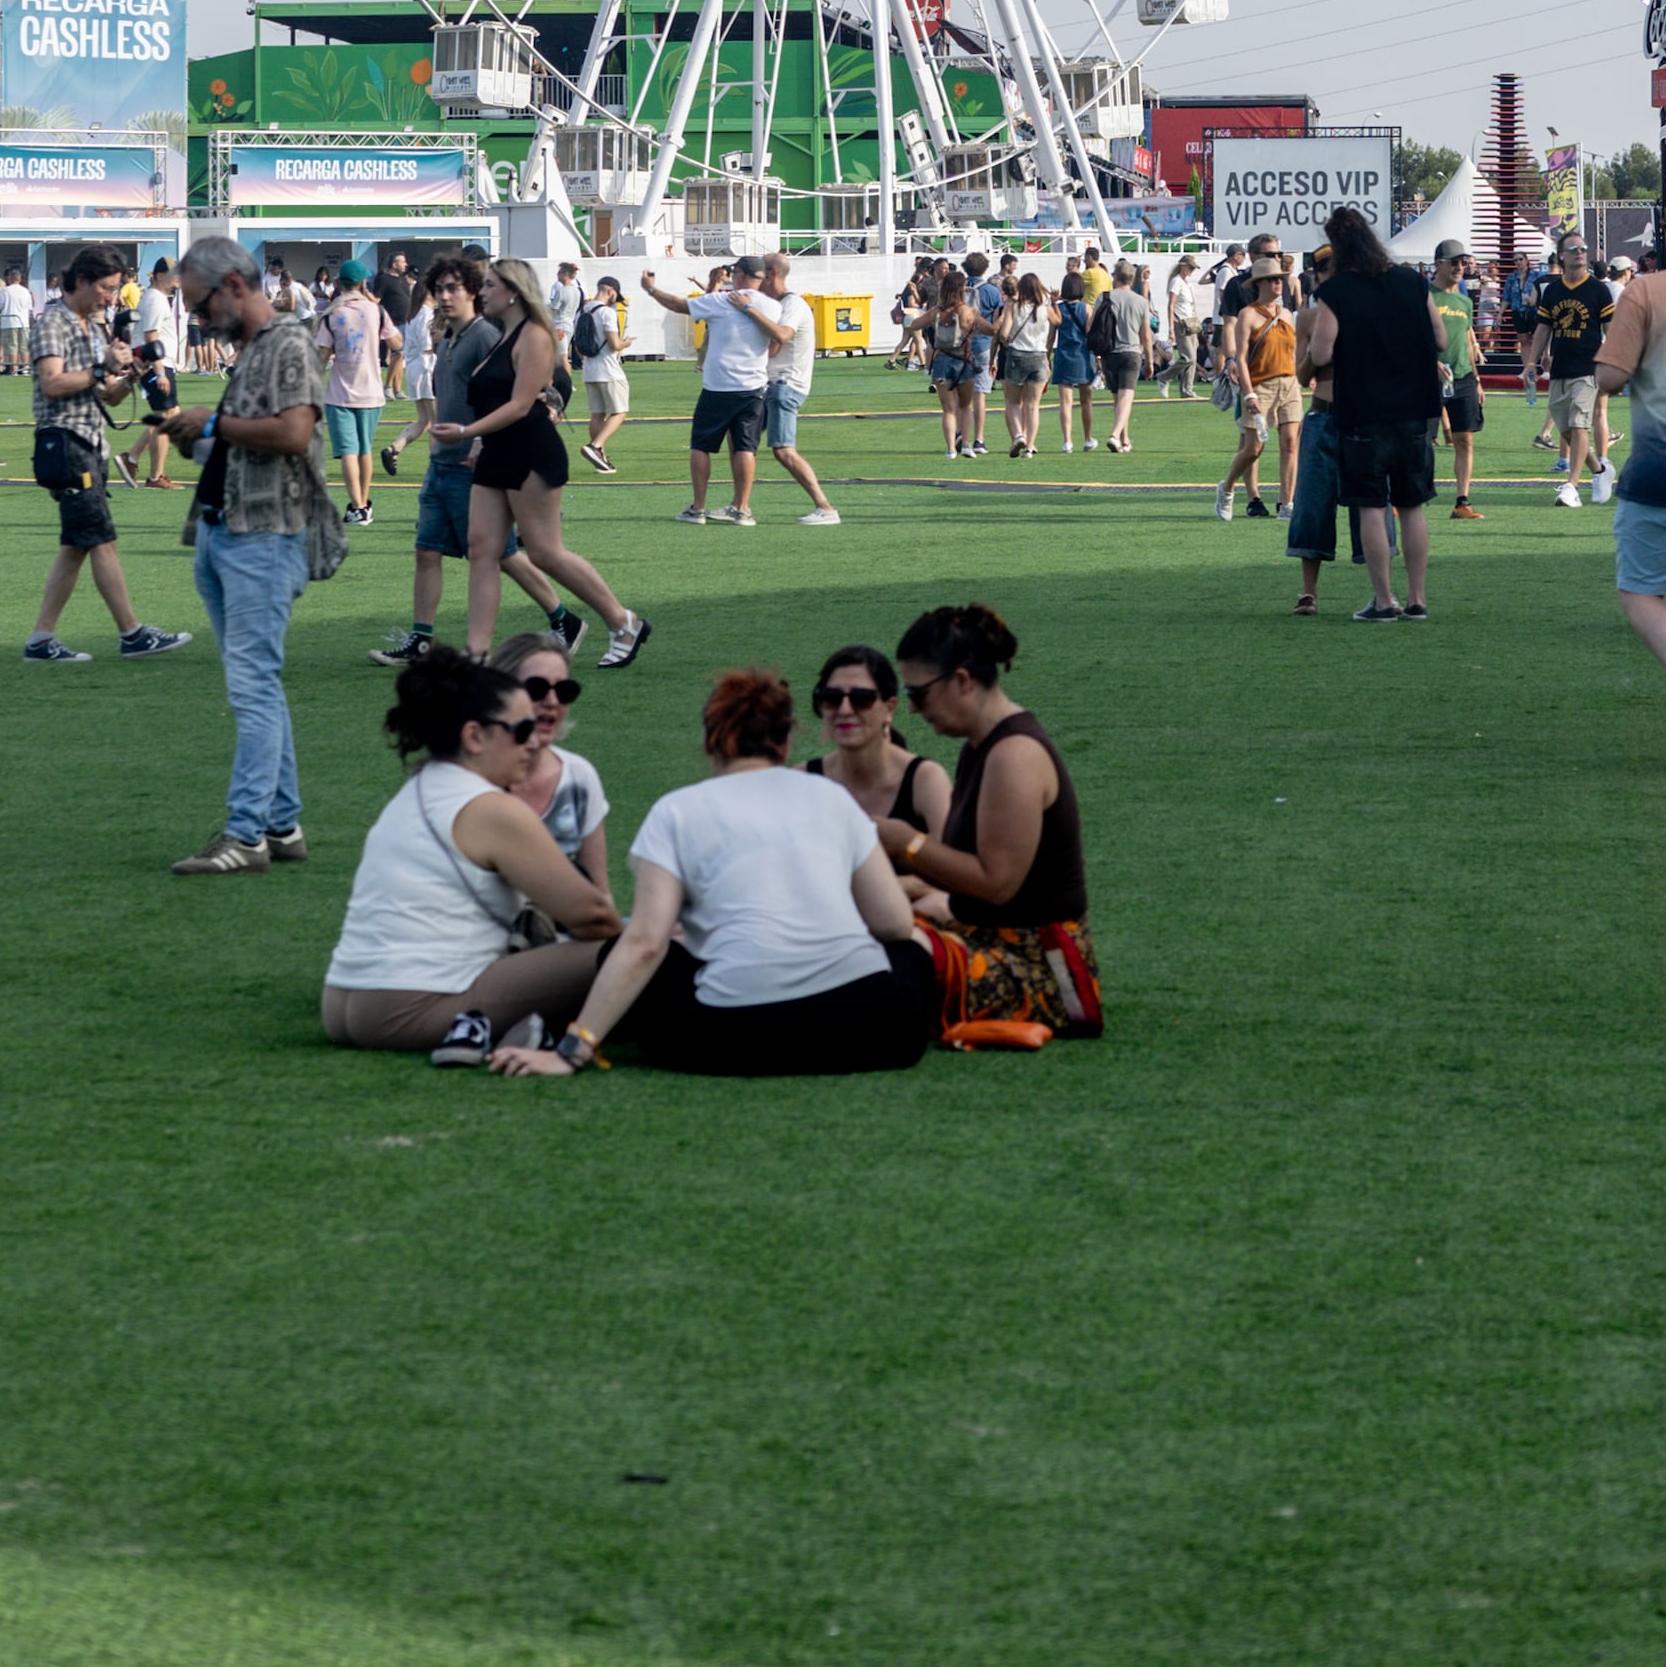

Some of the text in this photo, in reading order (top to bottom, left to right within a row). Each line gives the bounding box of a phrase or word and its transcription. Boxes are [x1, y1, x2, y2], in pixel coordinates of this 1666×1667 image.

[20, 16, 171, 62] CASHLESS
[27, 158, 106, 180] CASHLESS
[275, 159, 417, 180] RECARGA CASHLESS
[1225, 171, 1379, 197] ACCESO VIP
[1226, 201, 1268, 226] VIP
